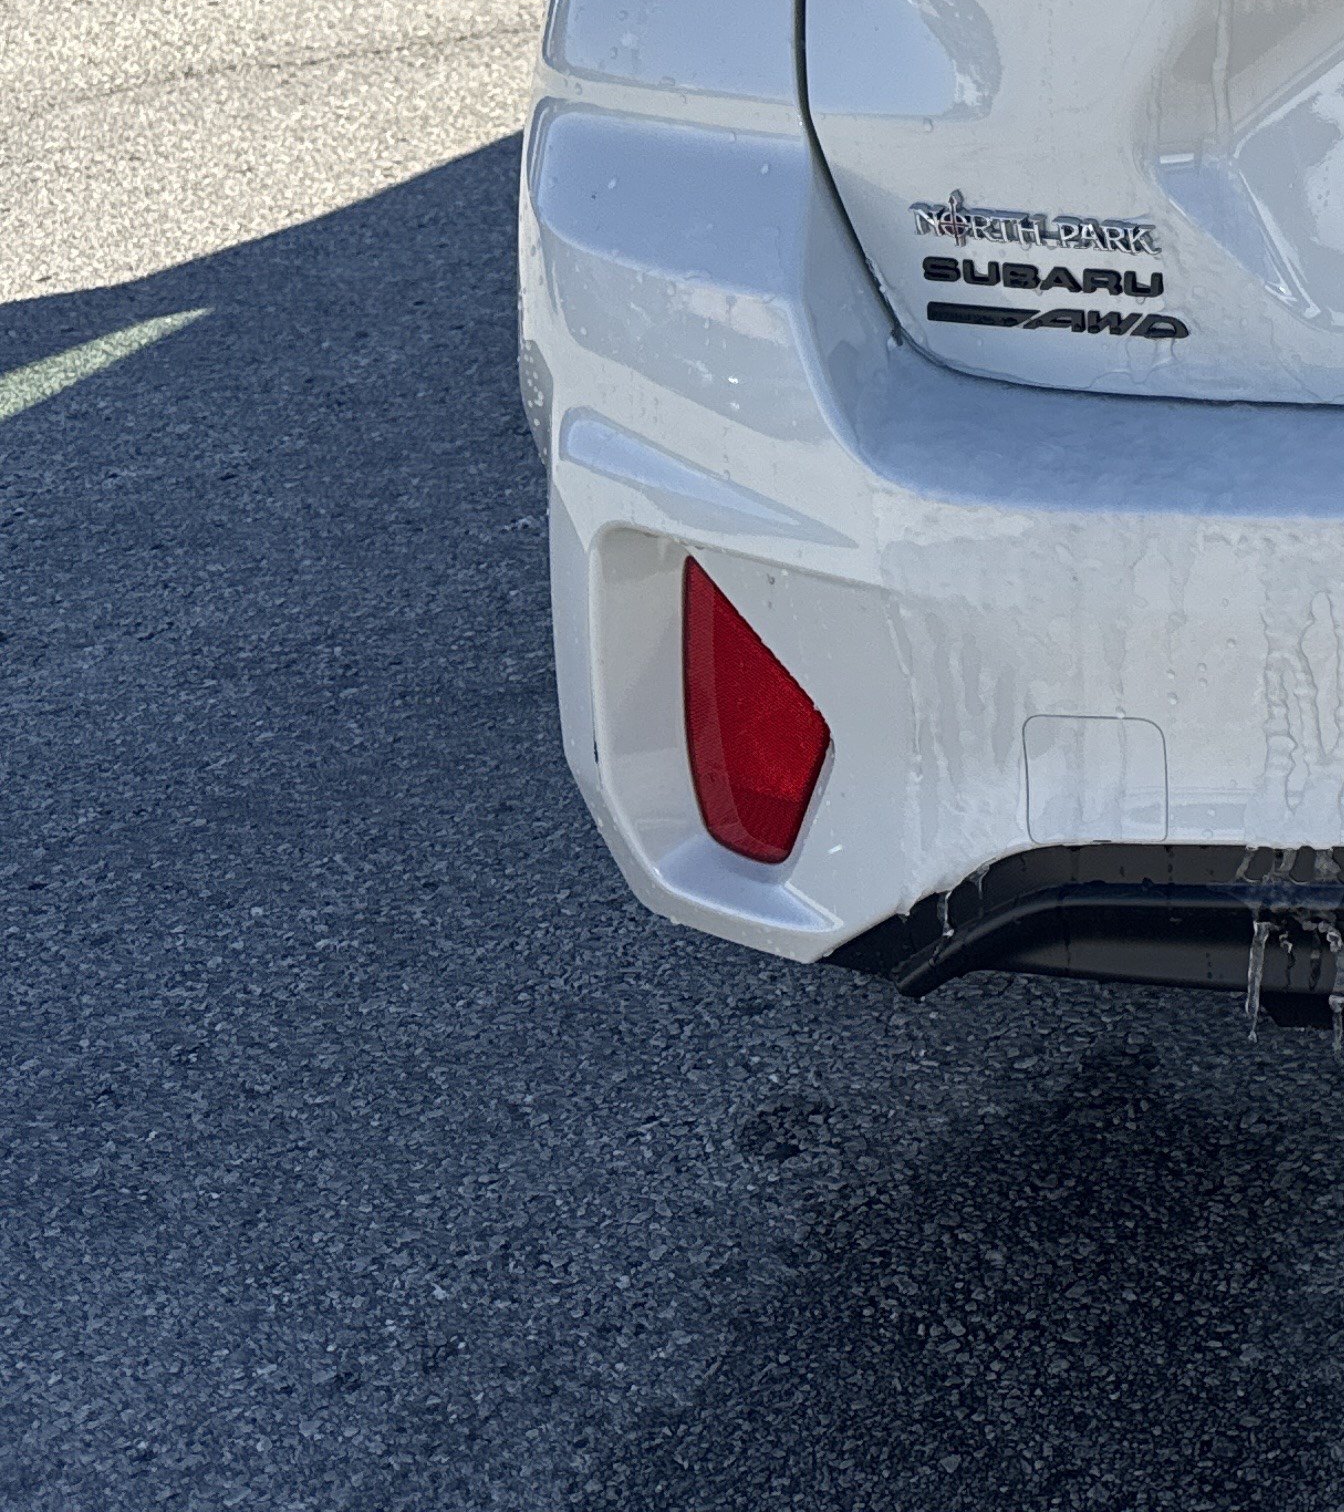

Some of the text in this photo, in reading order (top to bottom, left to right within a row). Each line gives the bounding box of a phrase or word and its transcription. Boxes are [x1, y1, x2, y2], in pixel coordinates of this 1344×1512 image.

[909, 191, 1162, 256] NORTH PARK
[922, 256, 1164, 298] SUBARU
[1024, 308, 1190, 340] AWD
